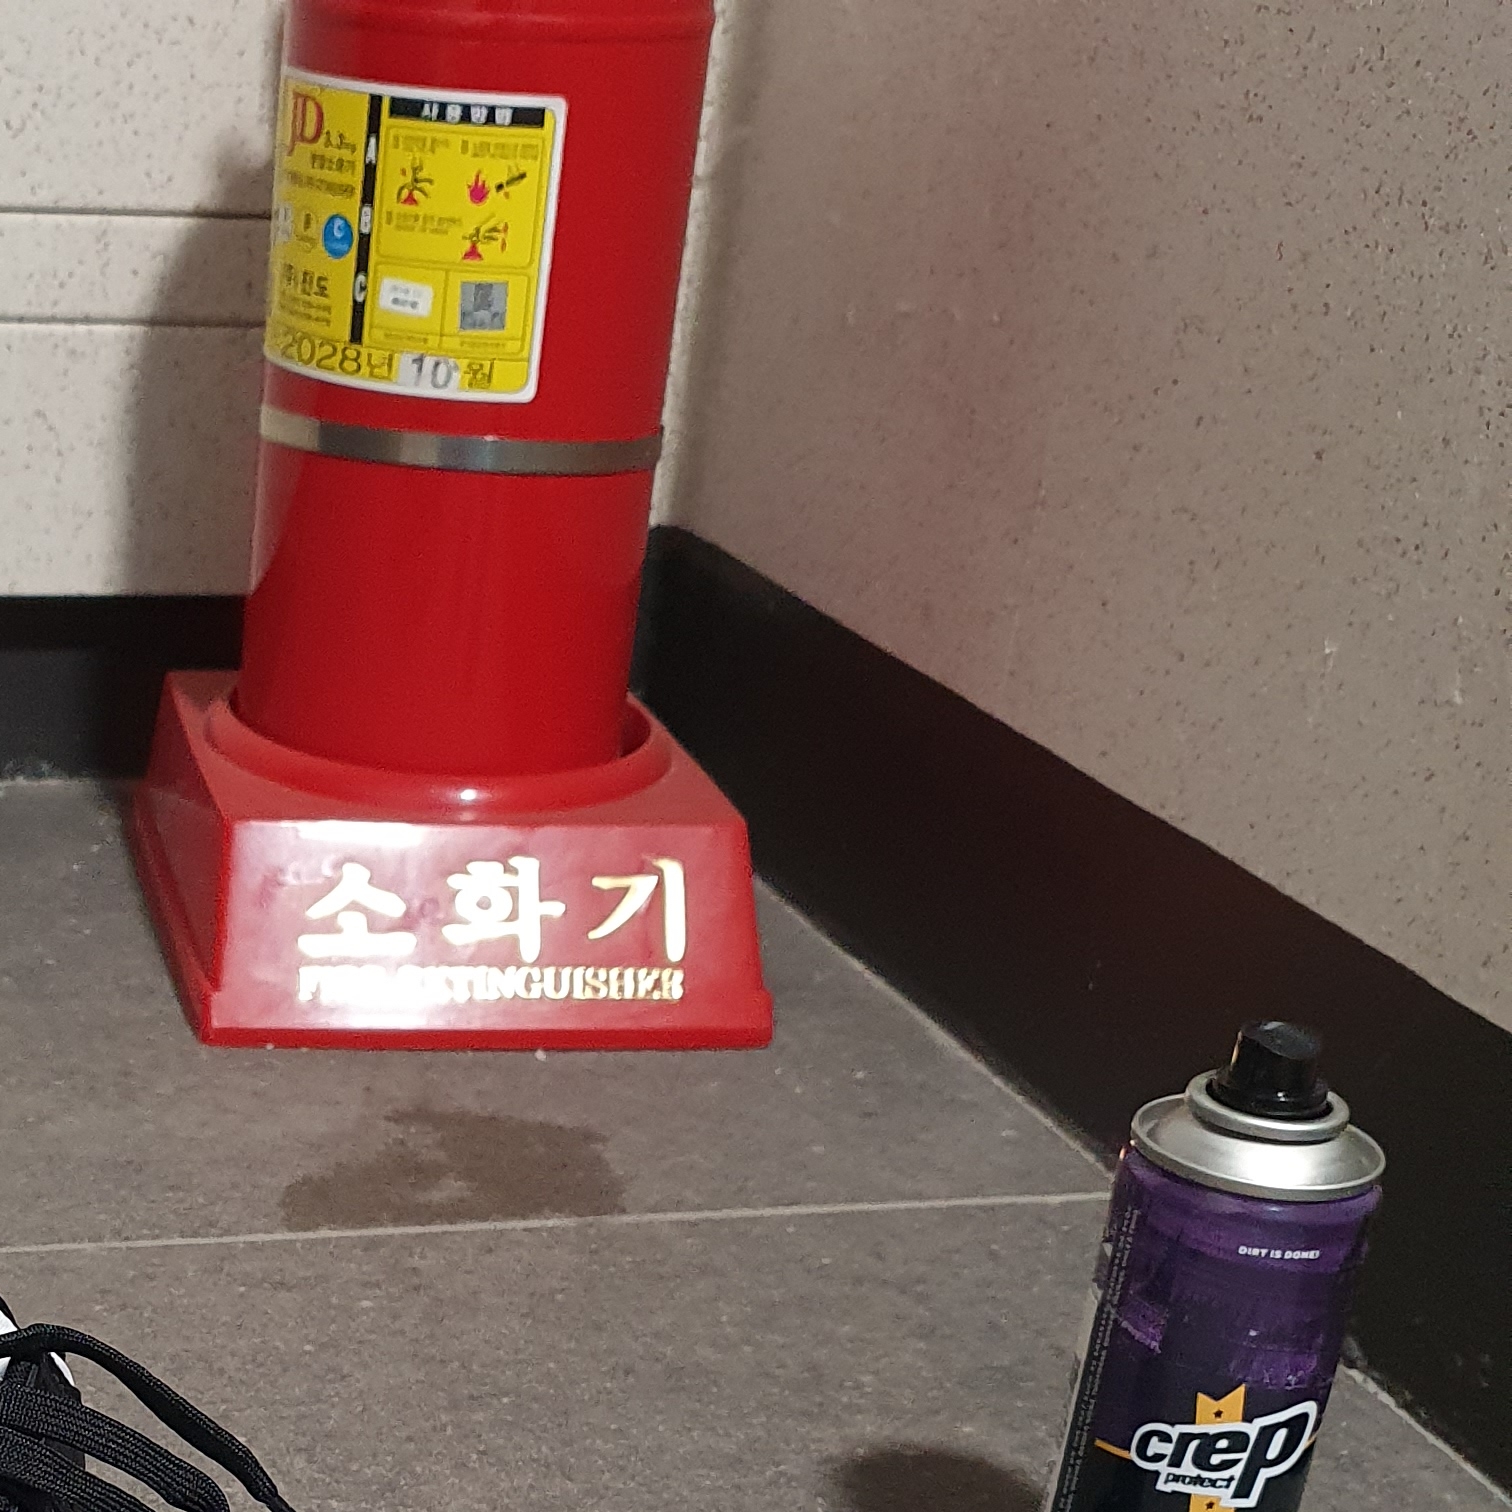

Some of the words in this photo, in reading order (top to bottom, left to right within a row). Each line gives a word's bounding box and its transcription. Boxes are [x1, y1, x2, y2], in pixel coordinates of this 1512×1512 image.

[1238, 1245, 1268, 1258] DIRT
[1270, 1249, 1283, 1259] IS
[1134, 1410, 1311, 1500] crep
[1164, 1472, 1235, 1490] protect
